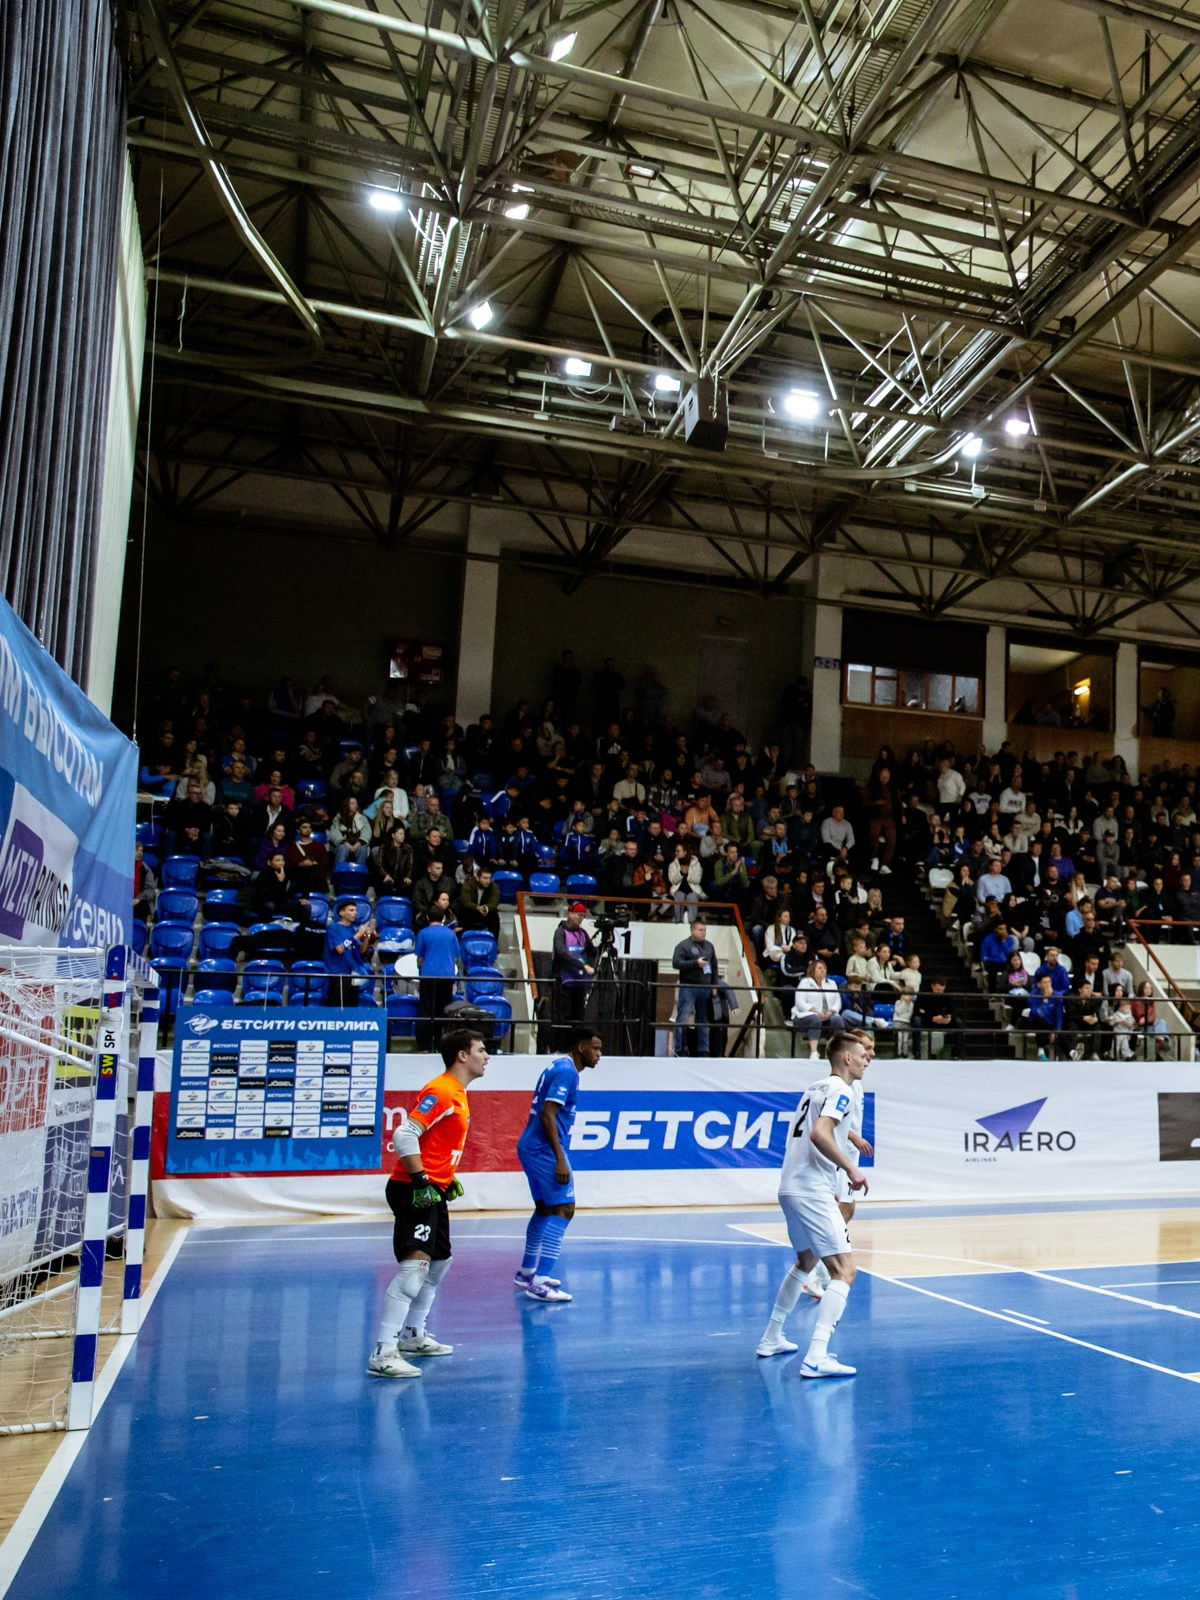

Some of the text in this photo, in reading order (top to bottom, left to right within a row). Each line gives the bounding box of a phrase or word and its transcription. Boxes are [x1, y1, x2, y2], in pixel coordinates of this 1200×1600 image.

[620, 931, 631, 954] 1
[221, 1019, 379, 1031] БЕТСИТИ СУПЕРЛИГА
[568, 1110, 797, 1151] БЕТСИ
[964, 1130, 1076, 1152] IRAERO
[414, 1223, 431, 1242] 23
